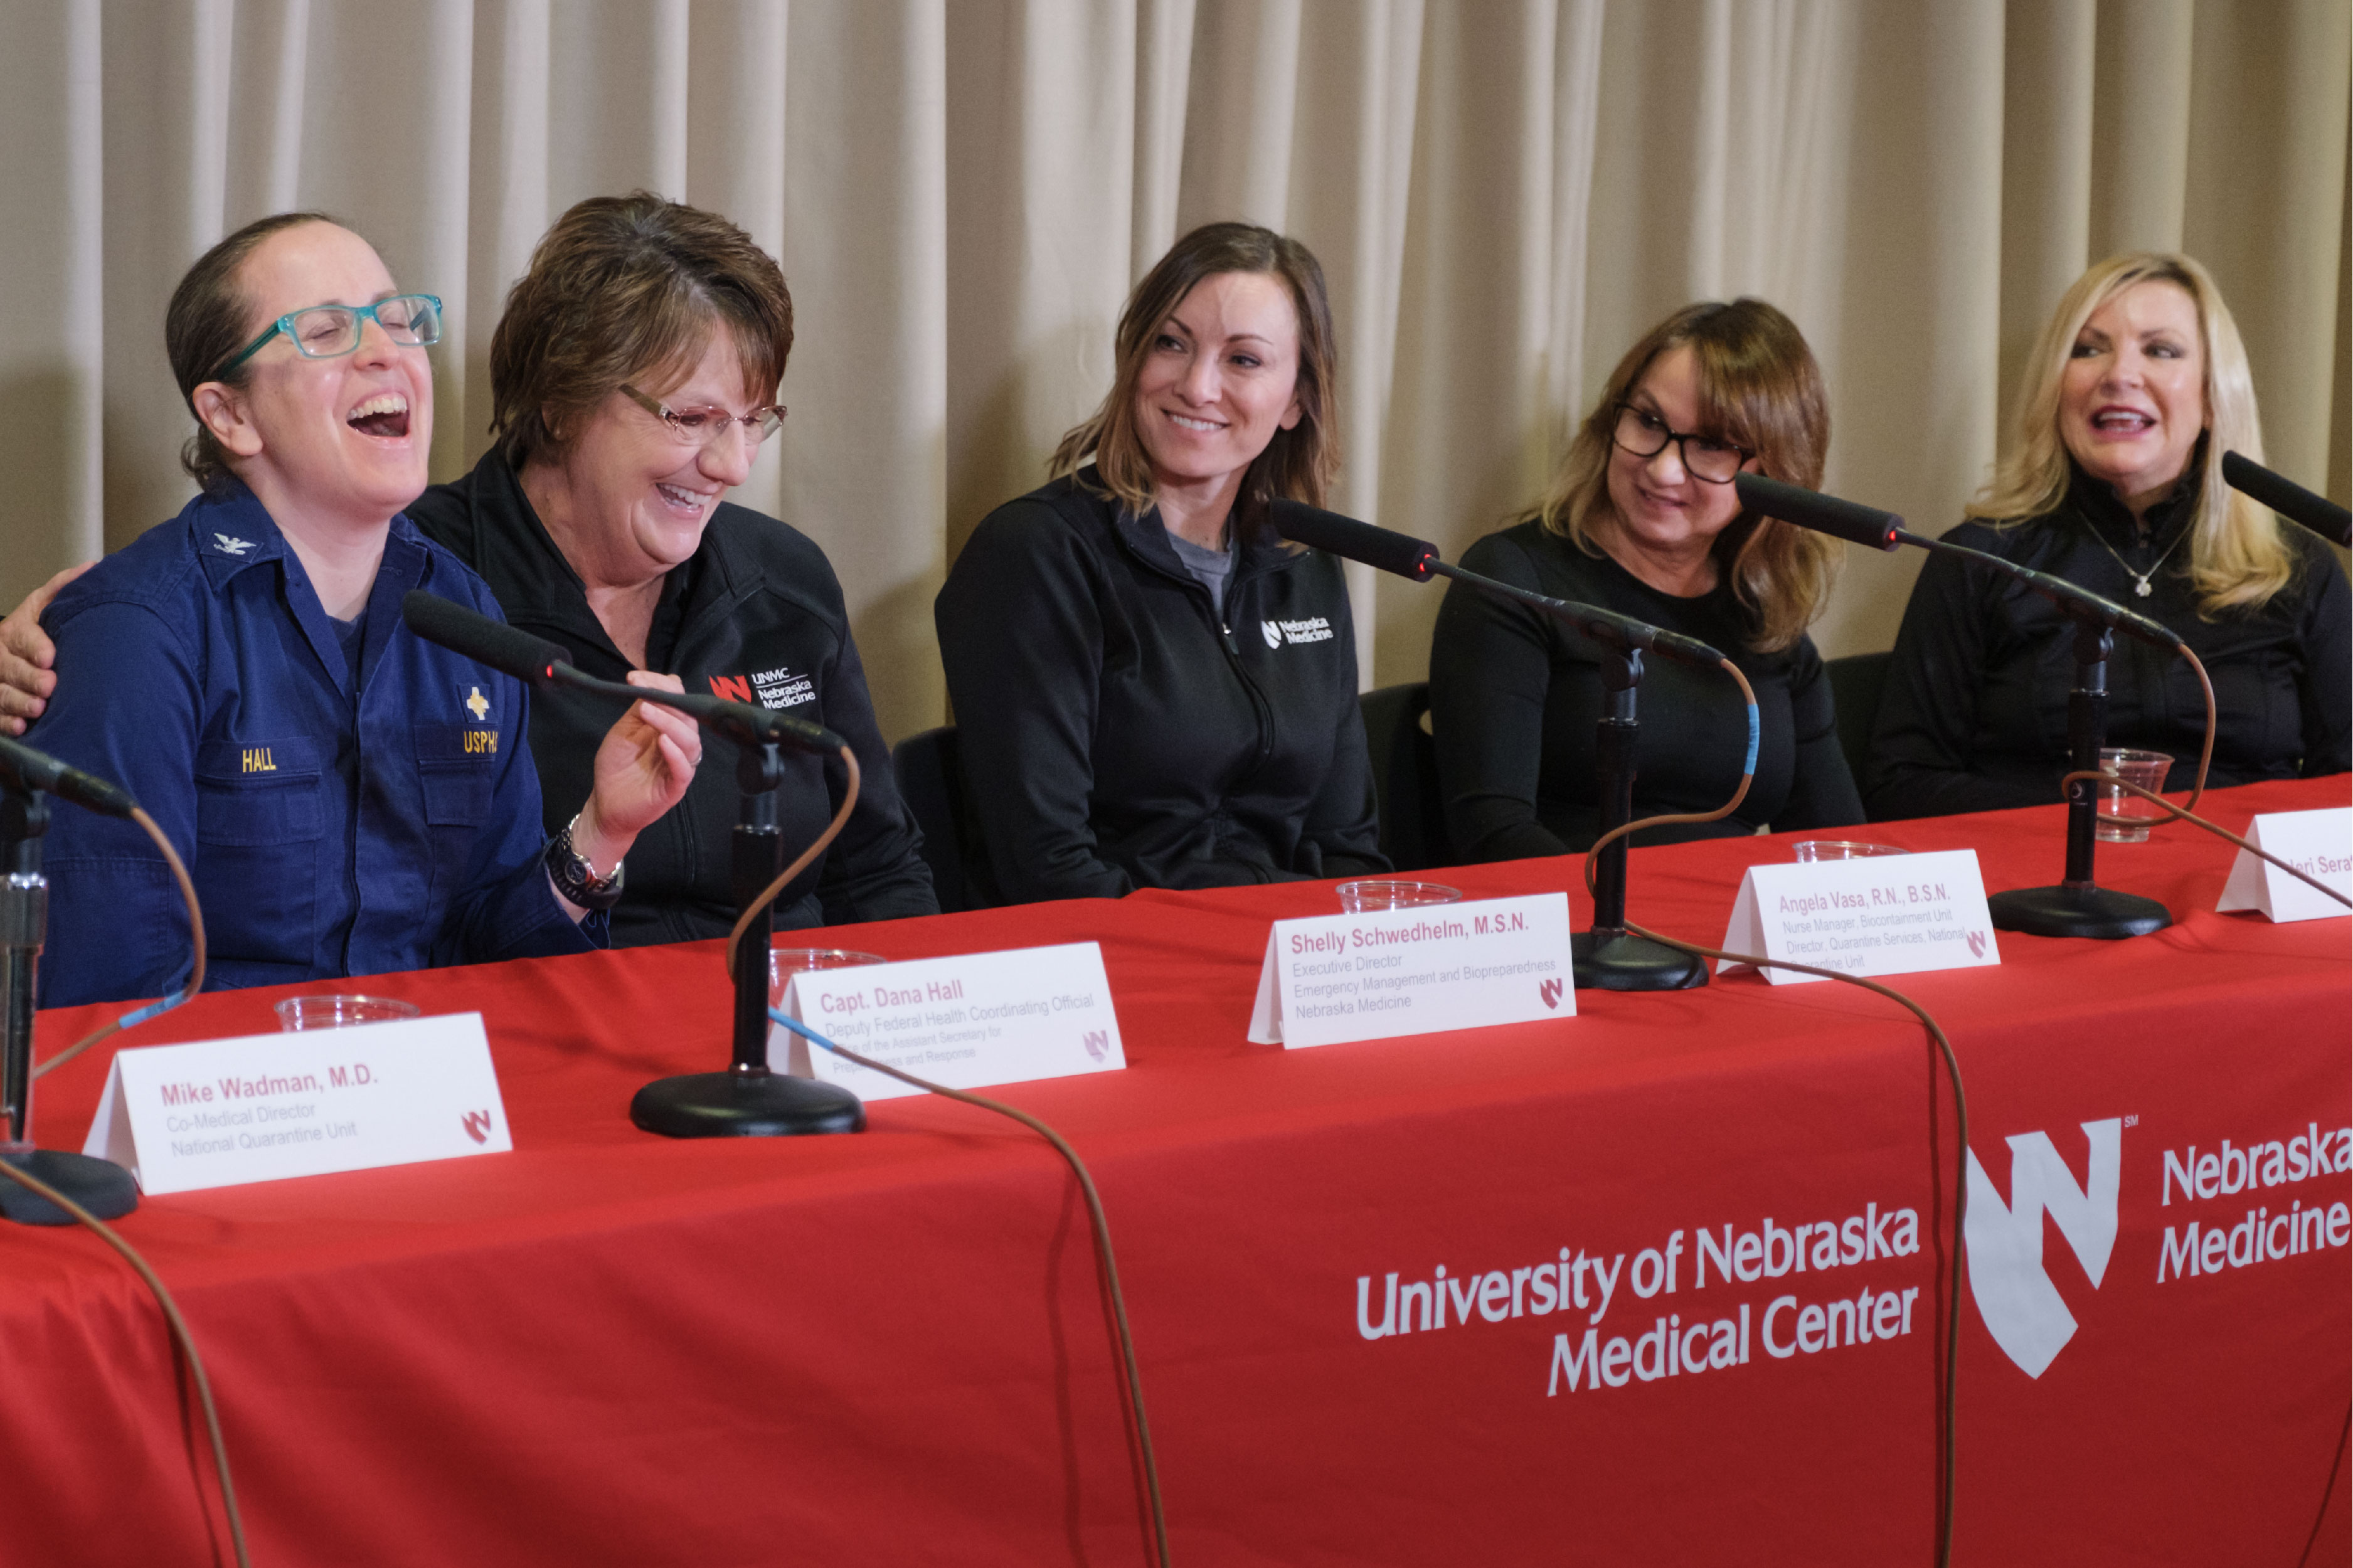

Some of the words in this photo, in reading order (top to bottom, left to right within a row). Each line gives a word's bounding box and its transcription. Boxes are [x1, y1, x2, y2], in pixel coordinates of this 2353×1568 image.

[1278, 617, 1329, 633] Nebraska
[1286, 628, 1333, 644] Medicine
[752, 667, 790, 685] UNMC
[758, 680, 812, 700] Nebraska
[763, 691, 815, 710] Medicine
[243, 748, 277, 773] HALL
[2318, 856, 2352, 874] Sera
[1780, 893, 1828, 916] Angela
[1830, 890, 1869, 909] Vasa,
[1872, 887, 1905, 906] R.N.,
[1908, 883, 1951, 903] B.S.N.
[1292, 930, 1346, 955] Shelly
[1352, 920, 1469, 948] Schwedhelm,
[1474, 912, 1529, 935] M.S.N.
[1783, 920, 1812, 934] Nurse
[1815, 918, 1858, 933] Manager,
[1861, 911, 1931, 929] Biocontainment
[1934, 909, 1952, 921] Unit
[1787, 940, 1828, 955] Director,
[1829, 933, 1881, 951] Quarantine
[1883, 931, 1926, 946] Services,
[1927, 926, 1966, 941] National
[1293, 961, 1352, 977] Executive
[1356, 953, 1402, 970] Director
[1845, 955, 1865, 968] Unit
[1294, 980, 1359, 999] Emergency
[1363, 972, 1436, 992] Management
[1440, 968, 1460, 983] and
[1463, 958, 1556, 981] Biopreparedness
[821, 990, 870, 1015] Capt.
[874, 984, 923, 1007] Dana
[926, 979, 964, 1002] Hall
[1296, 1002, 1355, 1019] Nebraska
[1358, 995, 1411, 1013] Medicine
[825, 1020, 871, 1039] Deputy
[874, 1013, 922, 1032] Federal
[925, 1008, 966, 1027] Health
[969, 1000, 1049, 1023] Coordinating
[1051, 993, 1095, 1011] Official
[874, 1040, 890, 1051] the
[893, 1034, 937, 1049] Assistant
[940, 1029, 985, 1043] Secretary
[989, 1025, 1002, 1038] for
[906, 1053, 923, 1066] and
[927, 1047, 976, 1063] Response
[161, 1083, 213, 1107] Mike
[218, 1072, 324, 1101] Wadman,
[329, 1064, 378, 1088] M.D.
[166, 1110, 253, 1133] Co-Medical
[257, 1103, 316, 1122] Director
[2125, 1115, 2138, 1128] SM
[171, 1138, 235, 1158] National
[238, 1126, 322, 1150] Quarantine
[326, 1121, 358, 1139] Unit
[2162, 1123, 2352, 1206] Nebraska
[2157, 1200, 2350, 1283] Medicine
[1357, 1247, 1624, 1340] University
[1631, 1231, 1684, 1298] of
[1695, 1202, 1920, 1289] Nebraska
[1547, 1304, 1750, 1397] Medical
[1762, 1286, 1918, 1359] Center
